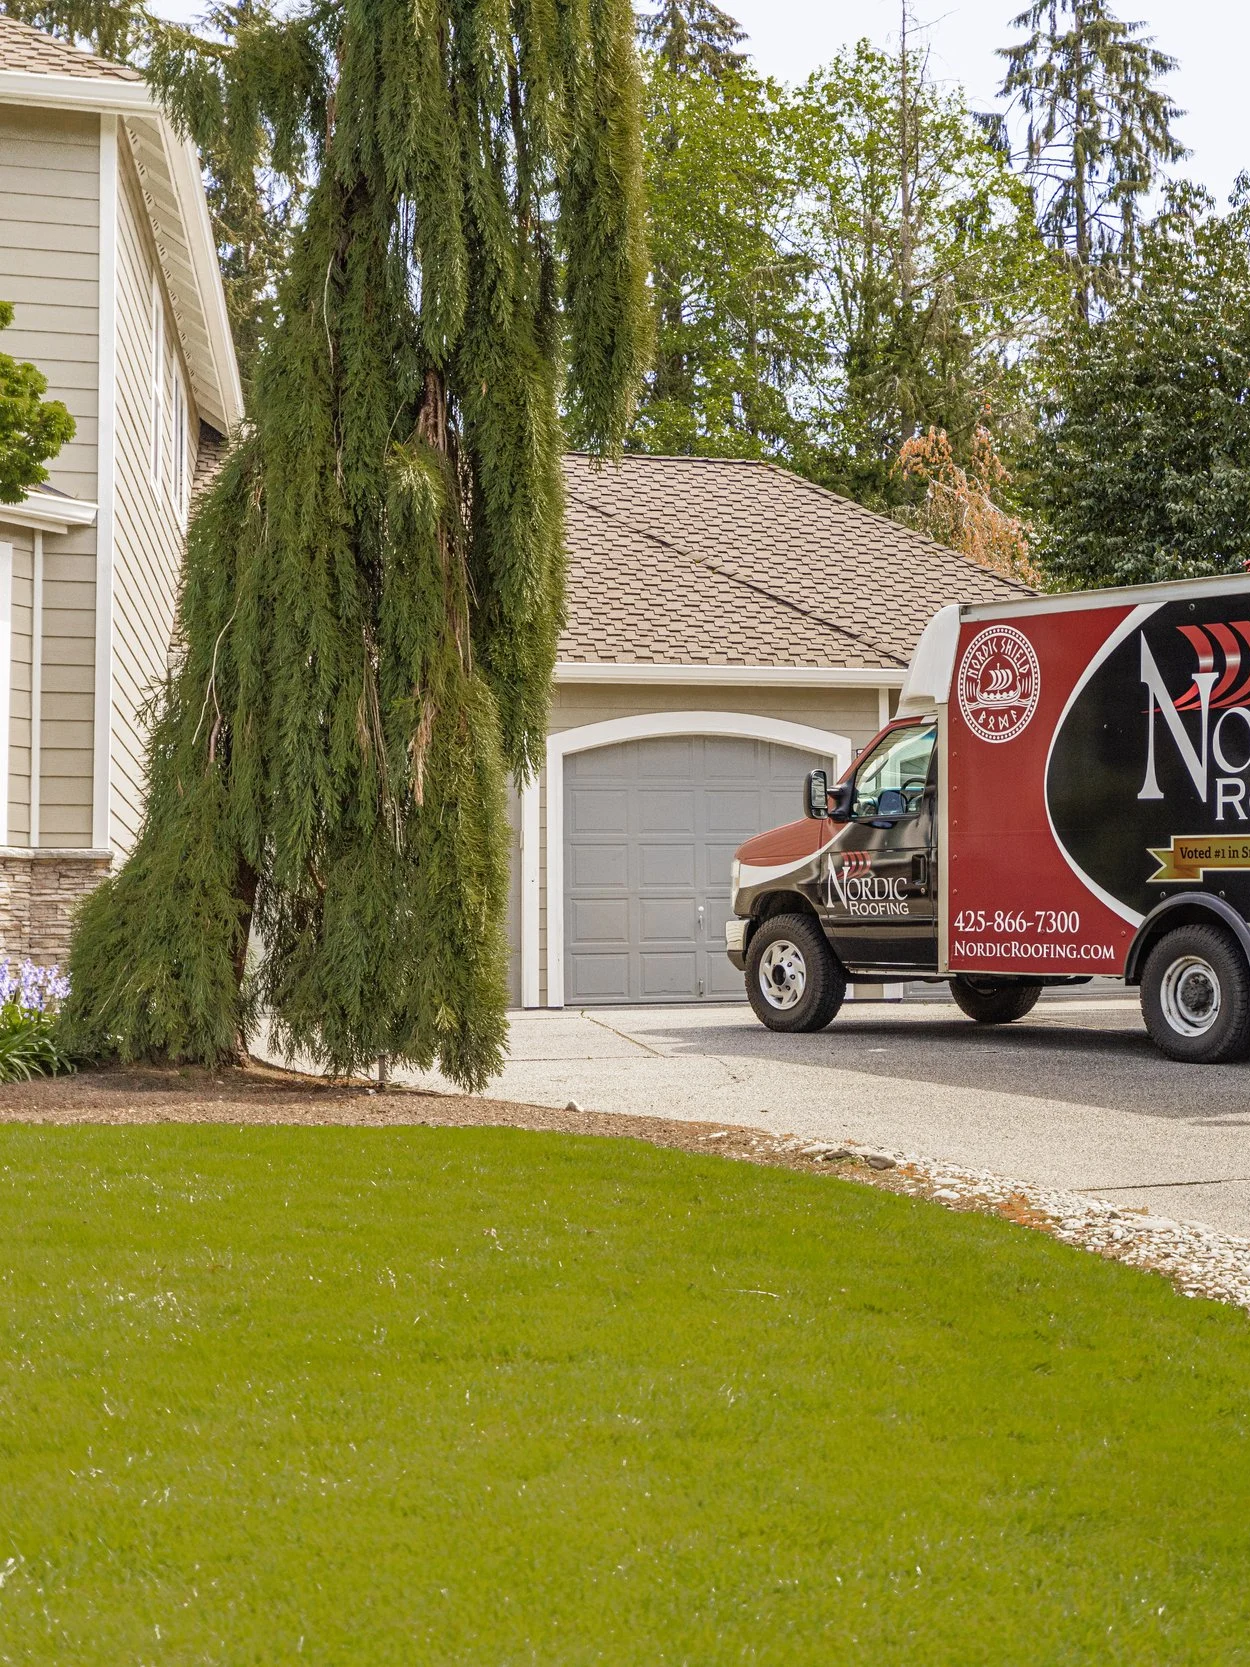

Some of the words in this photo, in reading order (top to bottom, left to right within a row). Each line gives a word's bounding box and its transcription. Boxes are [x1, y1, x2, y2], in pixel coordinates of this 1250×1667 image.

[967, 637, 998, 678] NORDIC
[1000, 637, 1030, 674] SHIELD
[1179, 845, 1211, 859] Voted
[1214, 847, 1226, 858] #1
[1228, 845, 1239, 859] in
[827, 853, 908, 910] NORDIC
[850, 902, 910, 916] ROOFING
[954, 910, 1080, 933] 425-866-7300
[954, 940, 1115, 960] NORDICROOFING.COM
